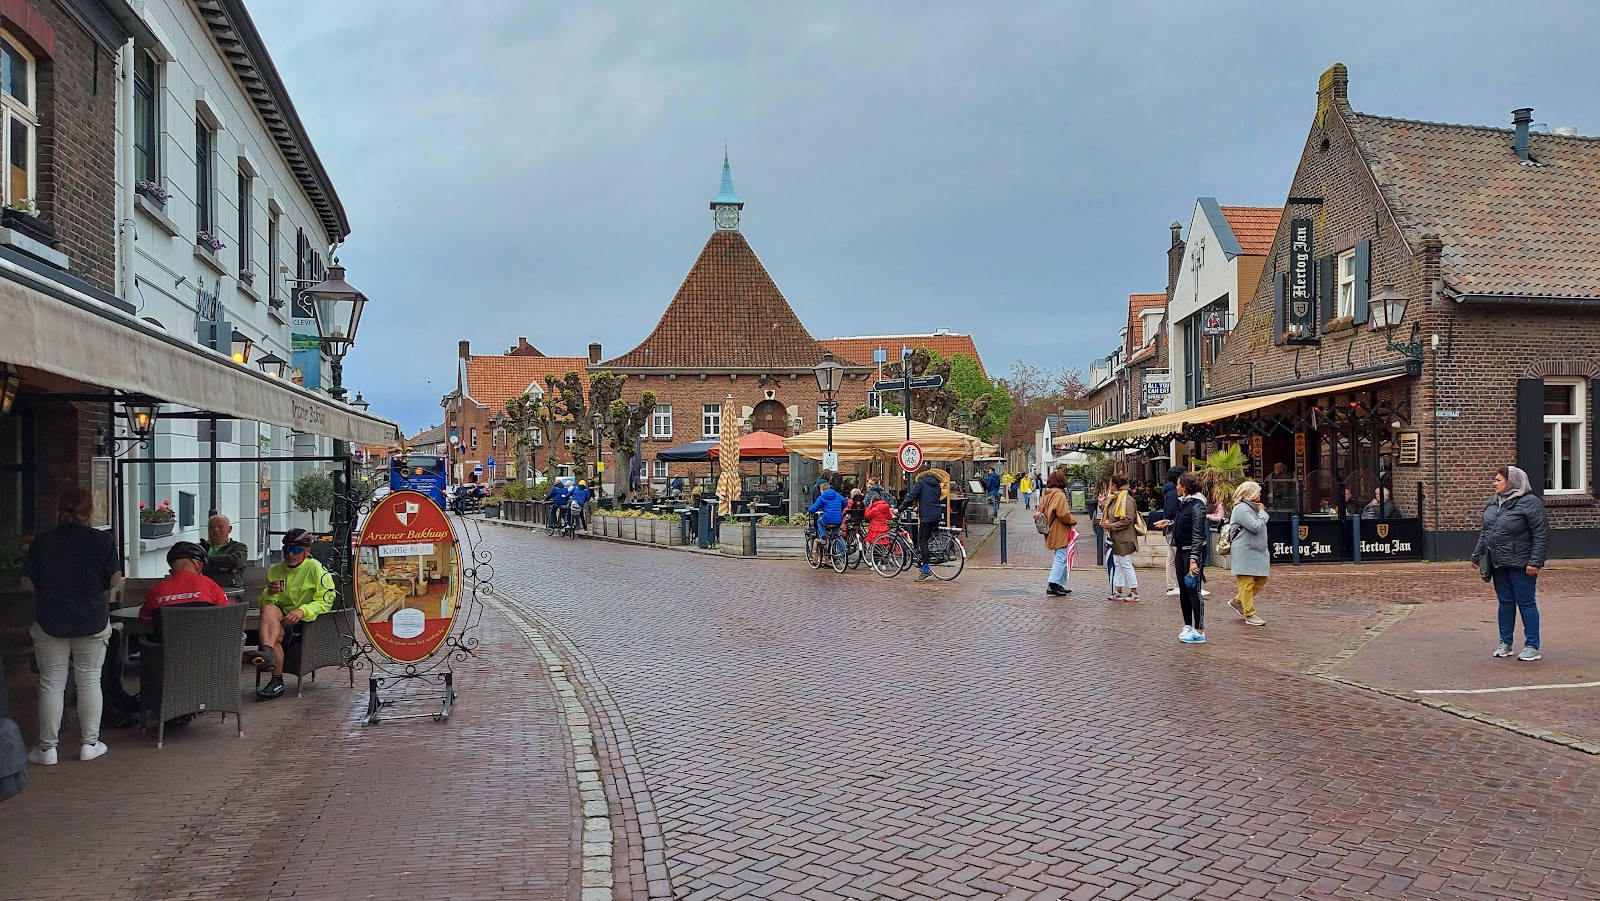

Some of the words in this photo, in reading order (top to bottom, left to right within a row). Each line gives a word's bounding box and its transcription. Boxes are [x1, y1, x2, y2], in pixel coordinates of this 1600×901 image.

[1293, 226, 1310, 253] Jan
[1292, 253, 1310, 299] Hertog
[365, 531, 406, 541] Arcener
[407, 527, 449, 542] Bakhuys
[383, 544, 407, 555] Koffie
[420, 546, 430, 554] go
[1310, 541, 1332, 558] Jan
[1391, 539, 1412, 556] Jan
[157, 591, 202, 604] TREK
